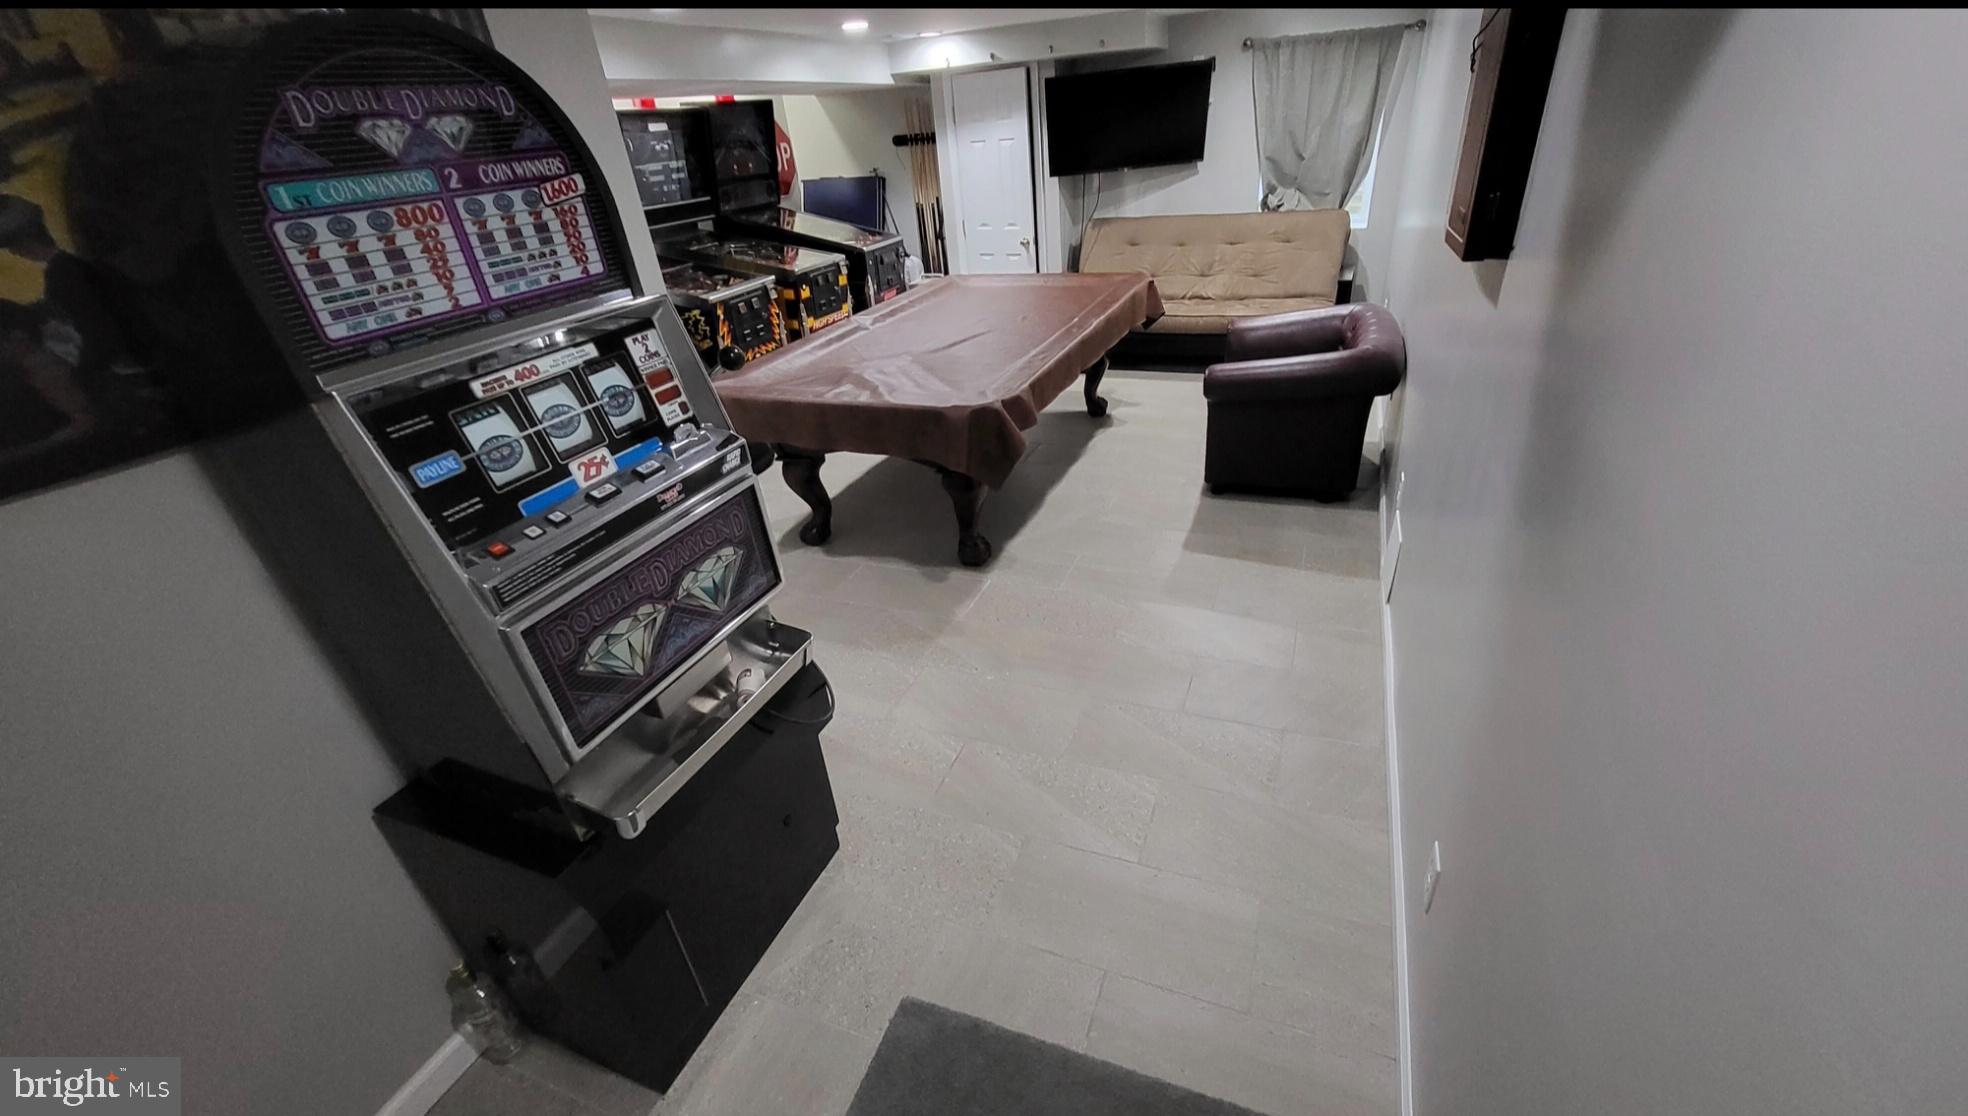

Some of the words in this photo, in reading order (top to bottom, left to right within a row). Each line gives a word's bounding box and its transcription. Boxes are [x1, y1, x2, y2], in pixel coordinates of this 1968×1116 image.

[444, 168, 463, 189] 2
[478, 163, 515, 184] COIN
[510, 157, 566, 179] WINNERS
[316, 177, 367, 204] COIN
[364, 170, 434, 199] WINNERS
[394, 202, 445, 228] 800
[632, 333, 650, 345] PLAY
[514, 364, 541, 382] 400
[416, 453, 459, 482] PAYLINE
